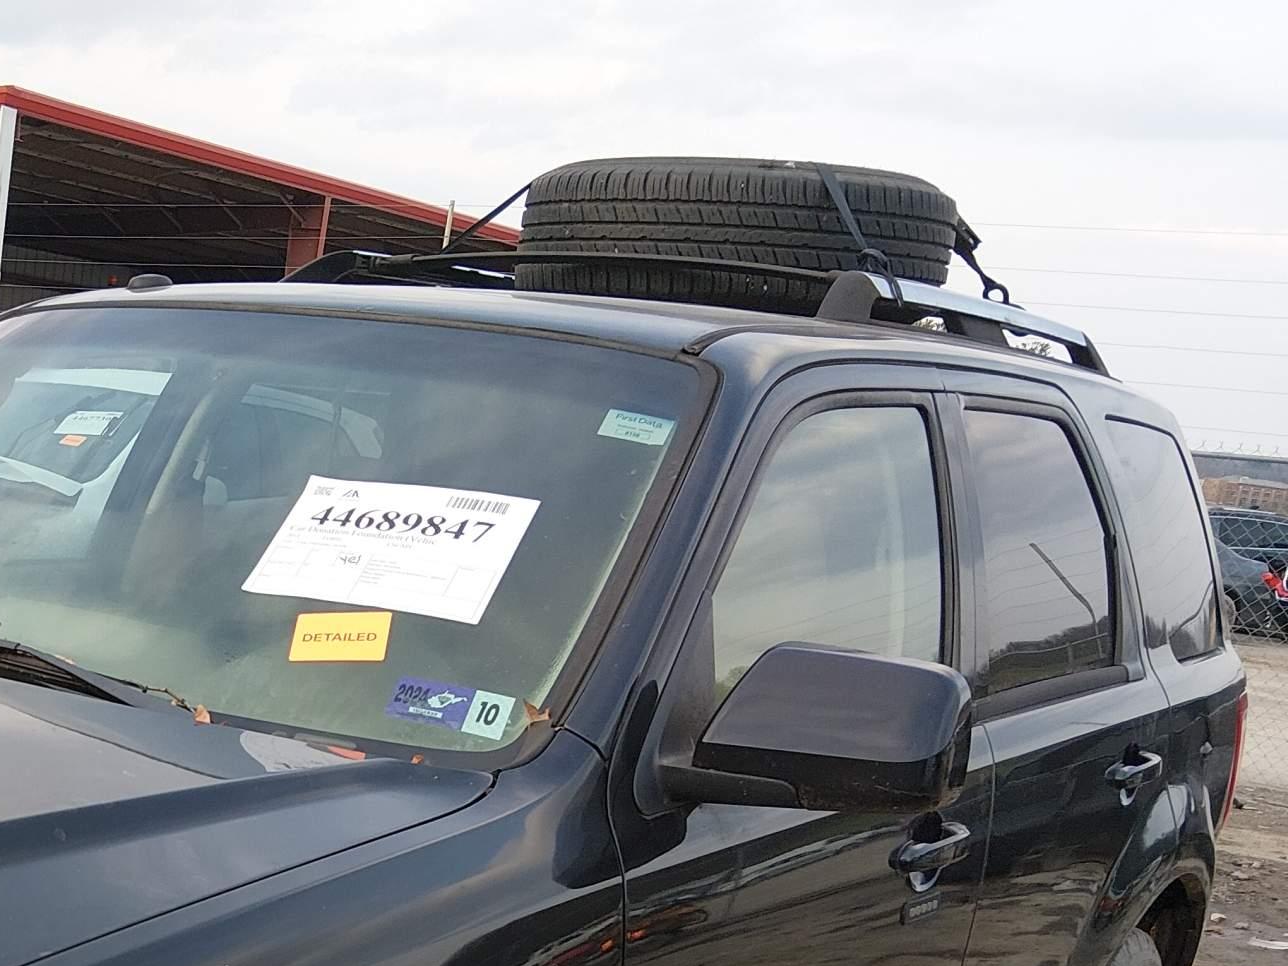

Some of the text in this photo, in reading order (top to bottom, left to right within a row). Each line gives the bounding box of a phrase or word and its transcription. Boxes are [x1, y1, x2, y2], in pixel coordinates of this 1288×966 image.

[311, 505, 497, 543] 44689847
[302, 631, 377, 643] DETAILED
[475, 701, 500, 726] 10
